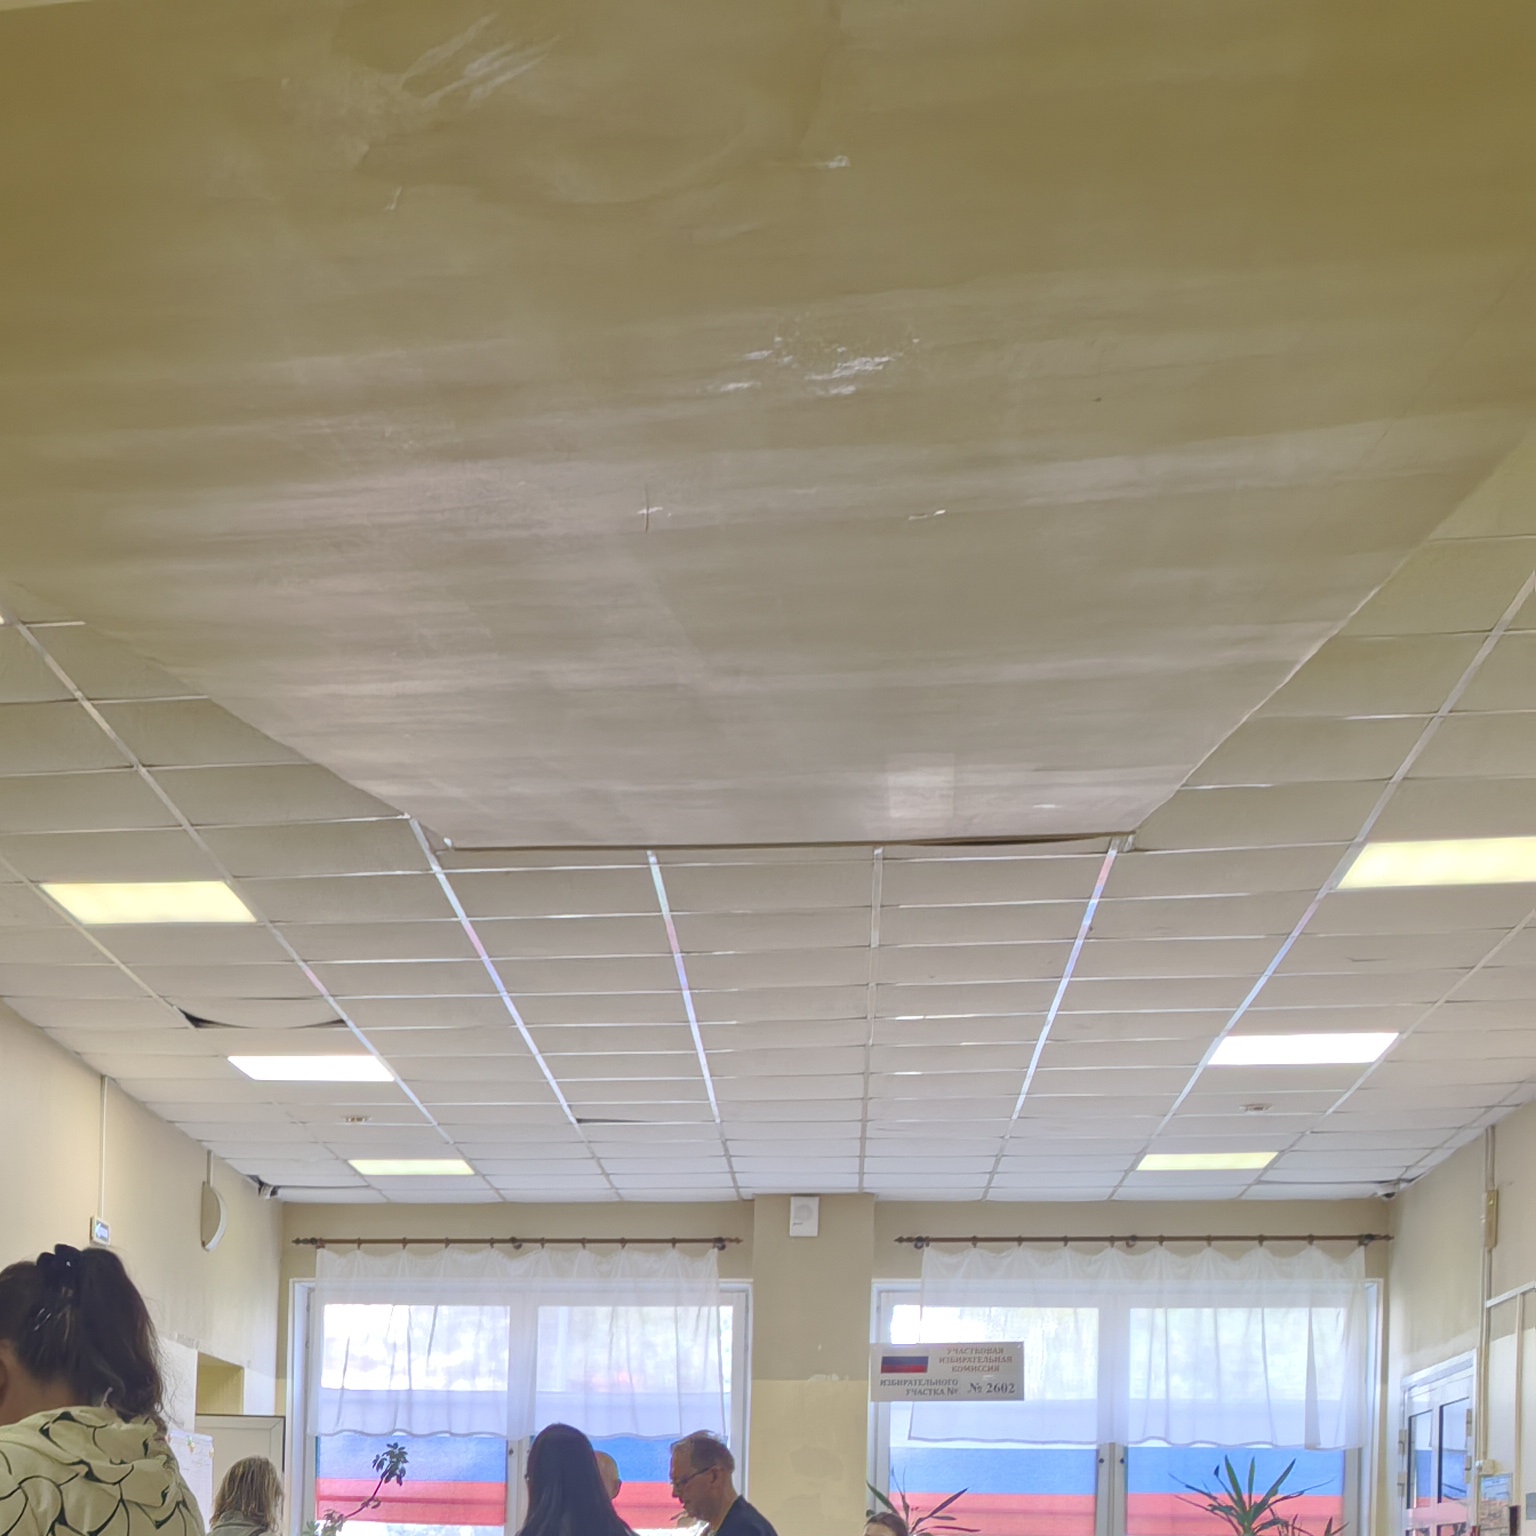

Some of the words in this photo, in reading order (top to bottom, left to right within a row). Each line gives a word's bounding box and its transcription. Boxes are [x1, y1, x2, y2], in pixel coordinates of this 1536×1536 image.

[906, 1388, 944, 1396] УЧАСТКА
[968, 1382, 982, 1393] №
[986, 1382, 1015, 1393] 2602
